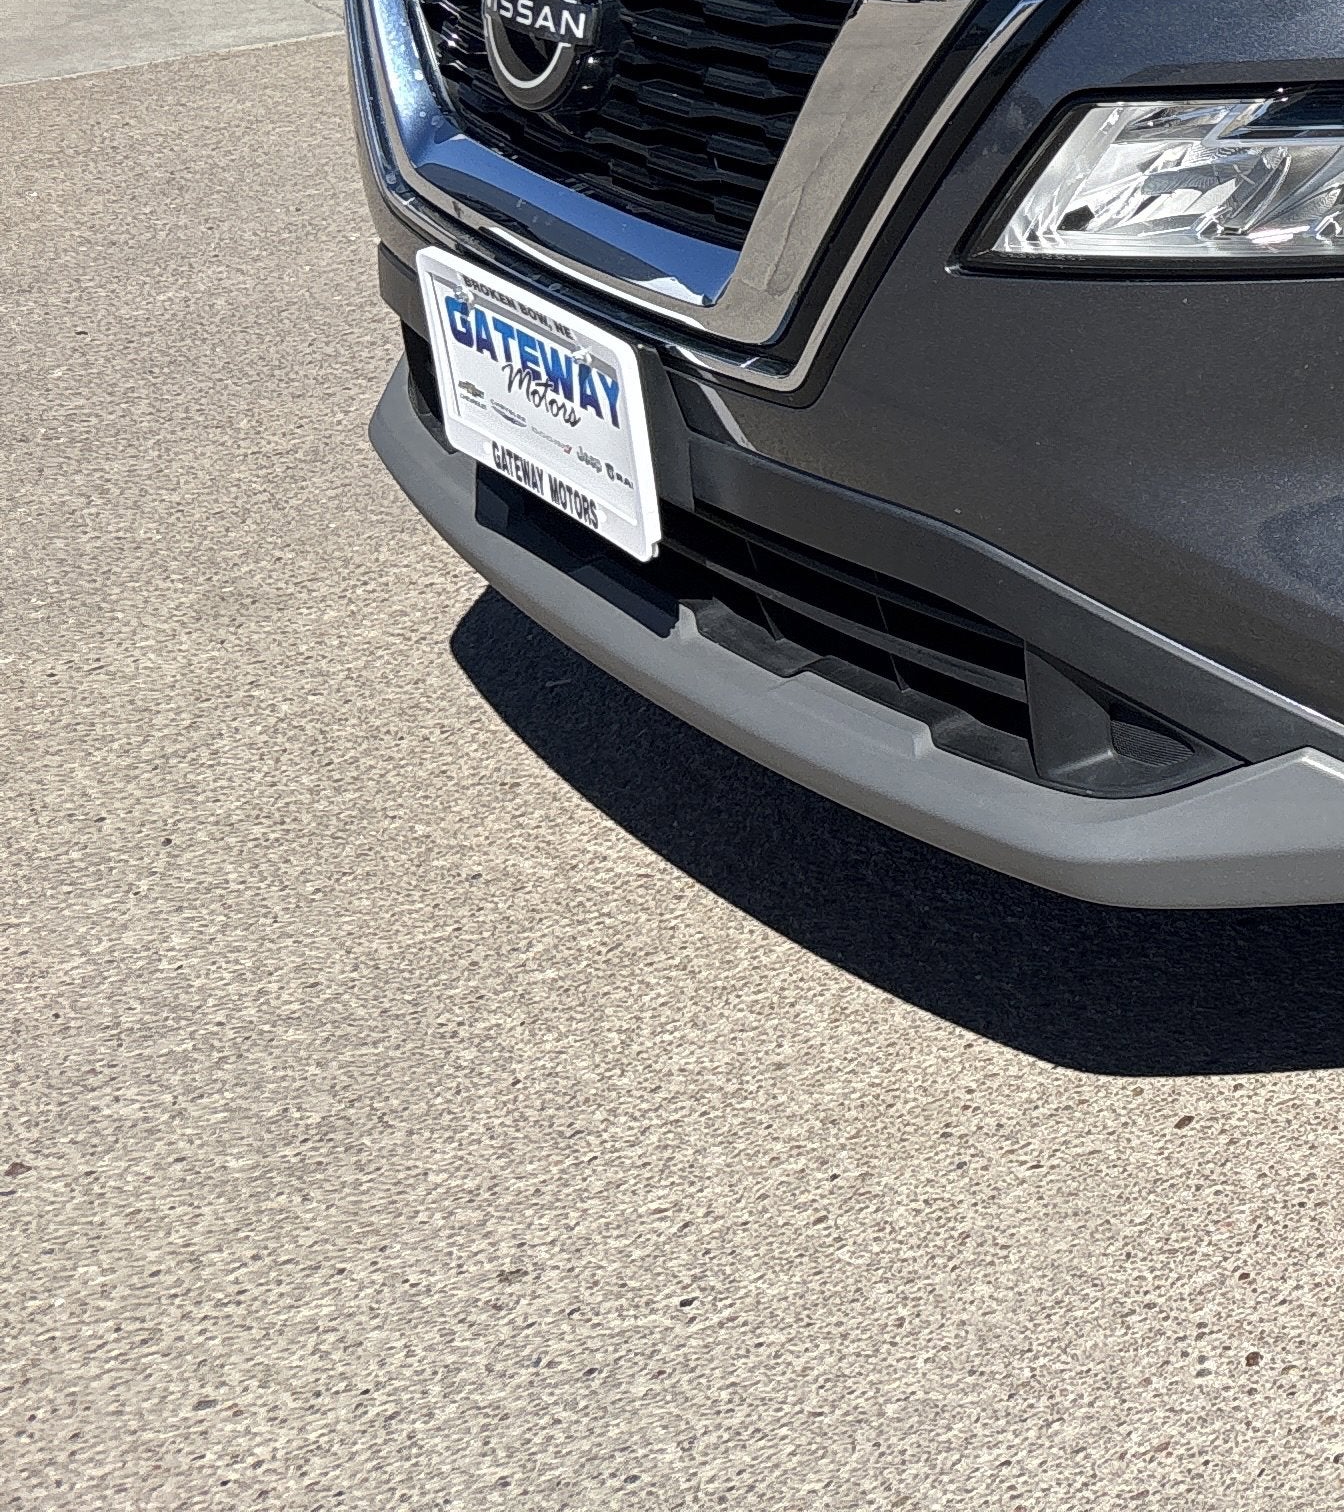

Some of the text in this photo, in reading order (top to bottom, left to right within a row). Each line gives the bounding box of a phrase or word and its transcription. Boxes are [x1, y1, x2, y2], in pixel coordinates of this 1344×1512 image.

[464, 275, 518, 311] BROKEN
[555, 324, 576, 341] NE
[444, 295, 621, 429] GATEWAY
[502, 363, 582, 428] Motors
[491, 440, 598, 529] GATEWAY MOTORS
